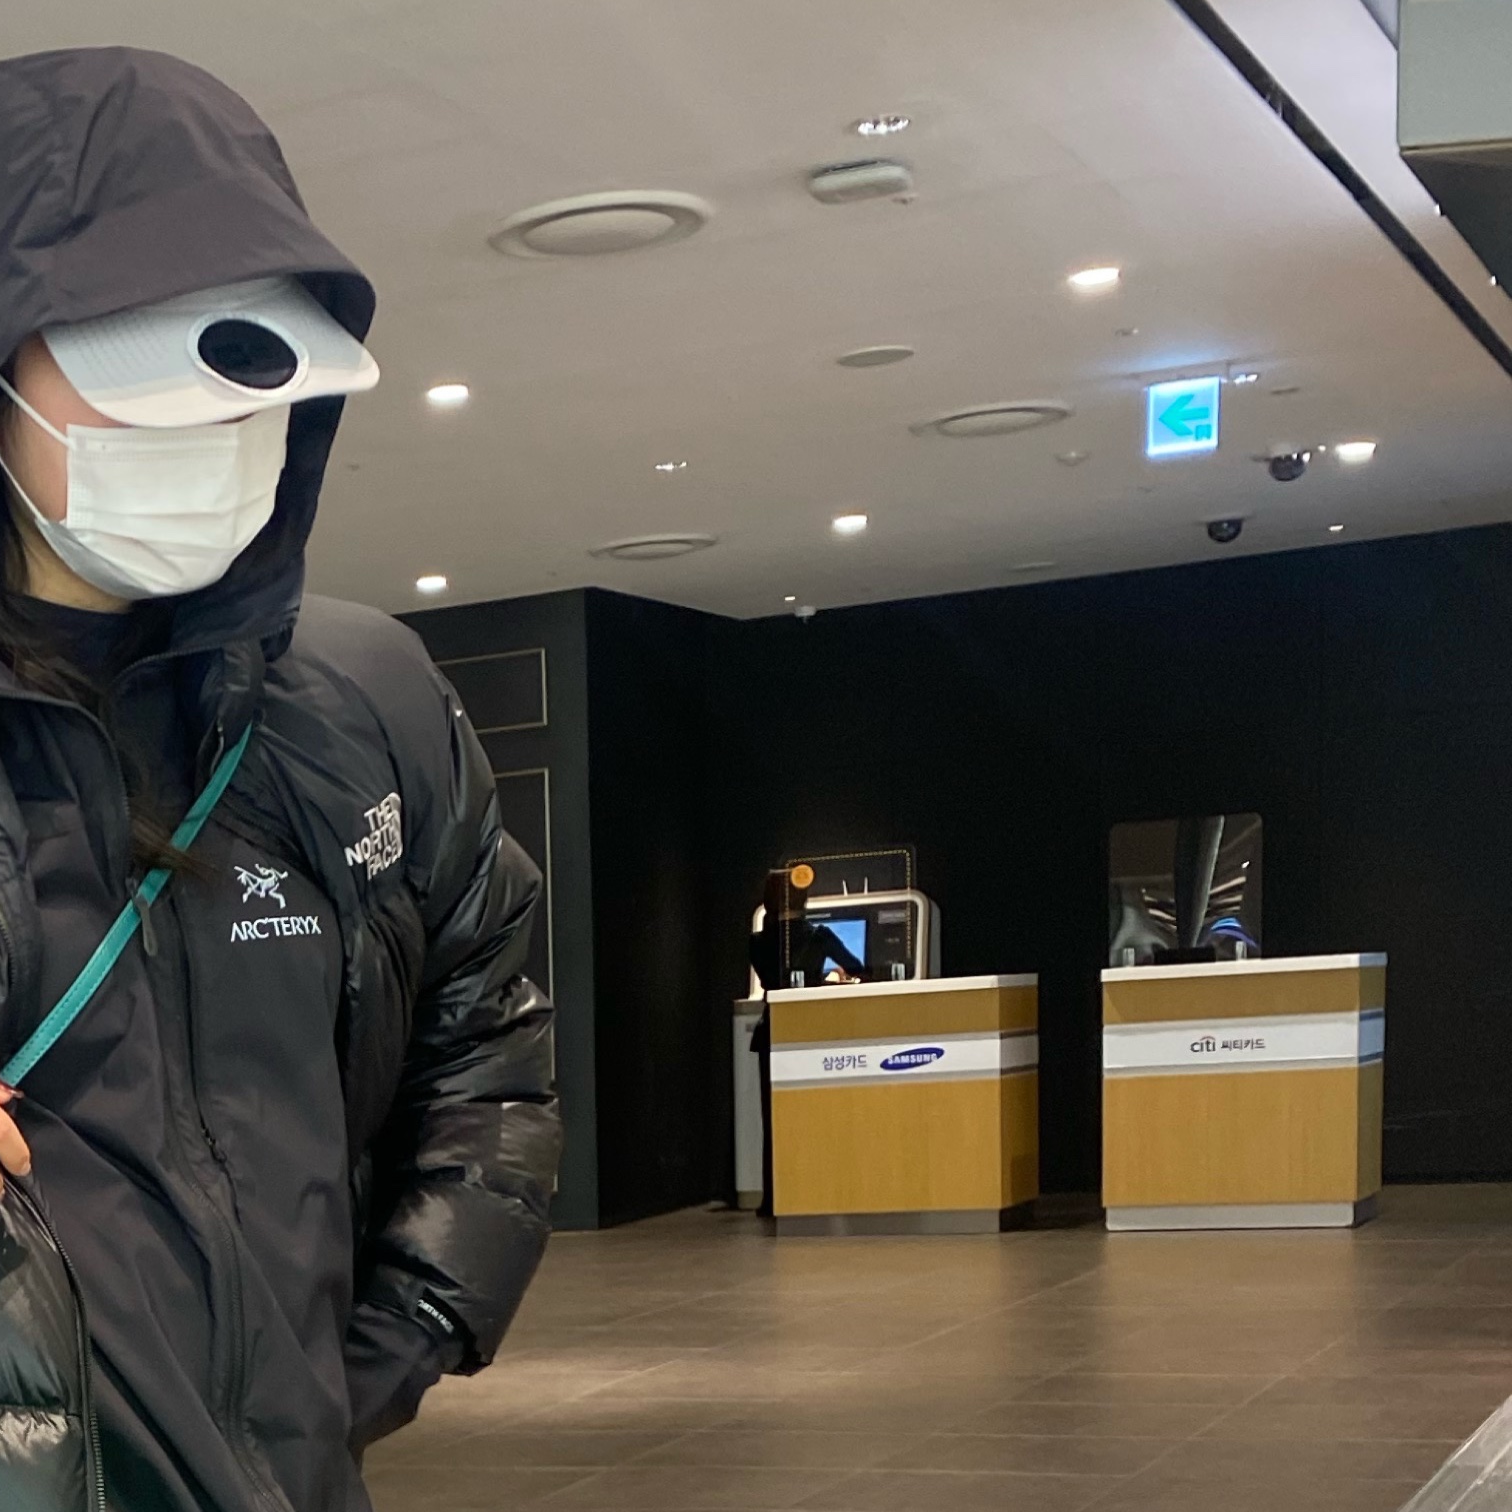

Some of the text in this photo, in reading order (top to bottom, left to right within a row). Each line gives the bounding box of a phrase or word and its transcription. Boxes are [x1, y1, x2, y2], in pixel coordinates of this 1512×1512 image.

[1190, 1035, 1266, 1053] citi 씨티카드
[822, 1051, 940, 1071] 삼성카드 SAMSUNG
